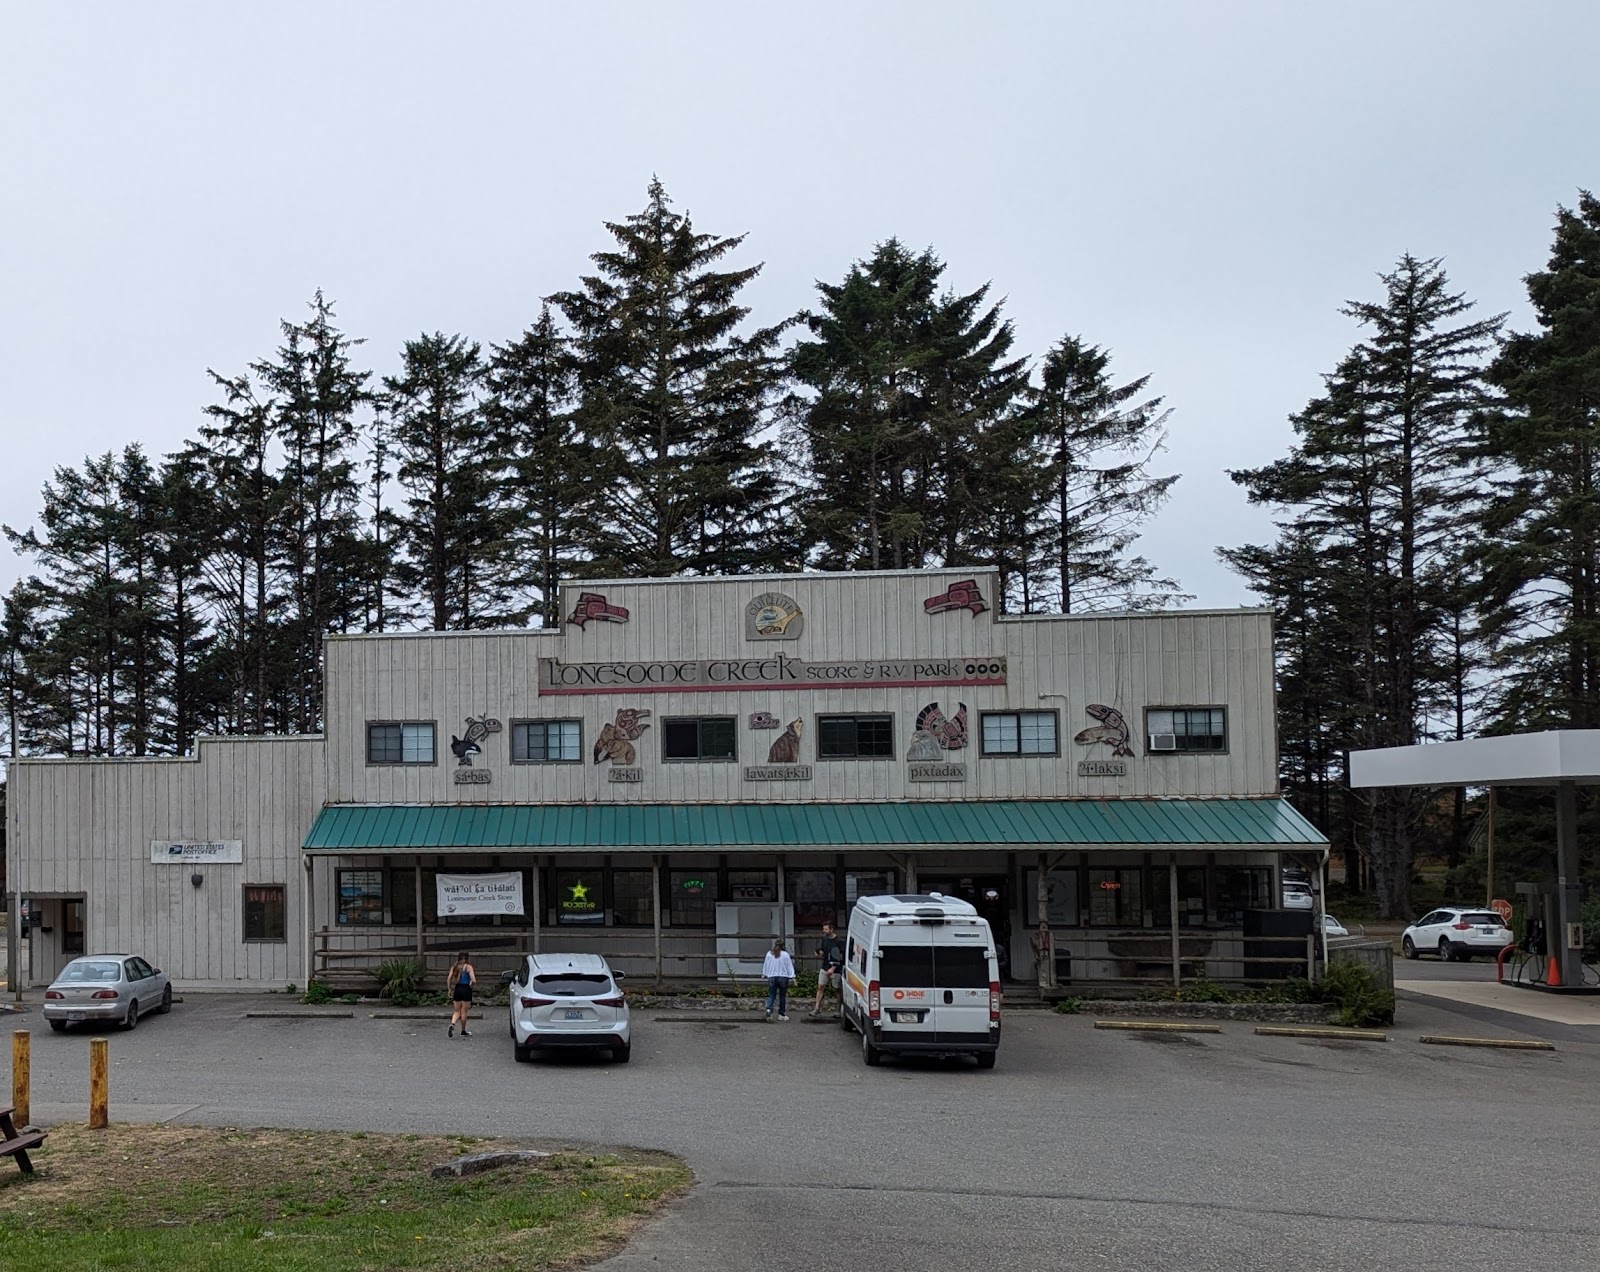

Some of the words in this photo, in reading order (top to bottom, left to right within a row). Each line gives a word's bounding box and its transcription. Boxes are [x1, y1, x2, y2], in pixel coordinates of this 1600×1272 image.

[549, 661, 697, 685] LONESOME
[708, 656, 797, 681] CREEK
[807, 666, 859, 679] STORE
[864, 661, 875, 679] &
[914, 660, 959, 681] PARK
